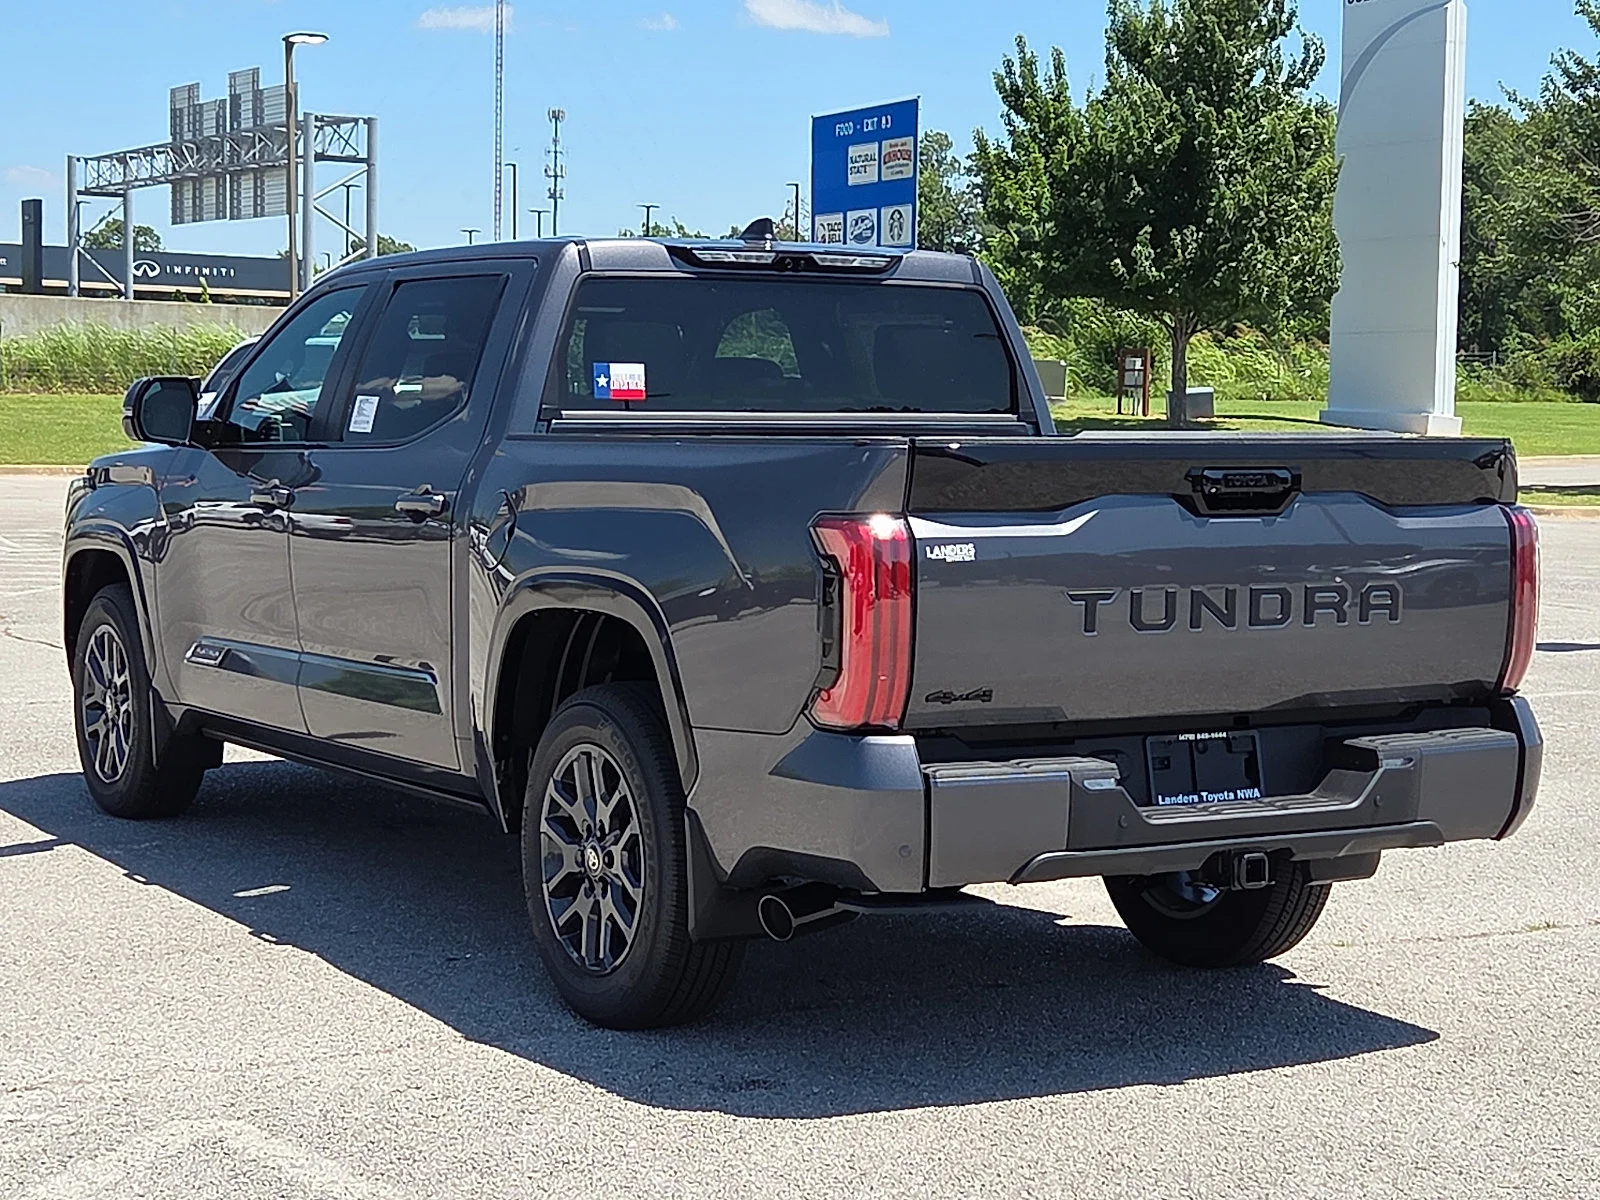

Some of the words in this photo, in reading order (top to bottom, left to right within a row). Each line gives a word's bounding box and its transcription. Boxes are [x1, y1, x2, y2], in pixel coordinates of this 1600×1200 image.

[849, 152, 877, 164] NATURAL
[849, 164, 868, 175] STATE
[166, 264, 235, 277] INFINITI
[1065, 580, 1404, 636] TUNDRA
[1158, 794, 1199, 805] Landers
[1200, 790, 1235, 803] Toyota
[1236, 787, 1261, 800] NWA
